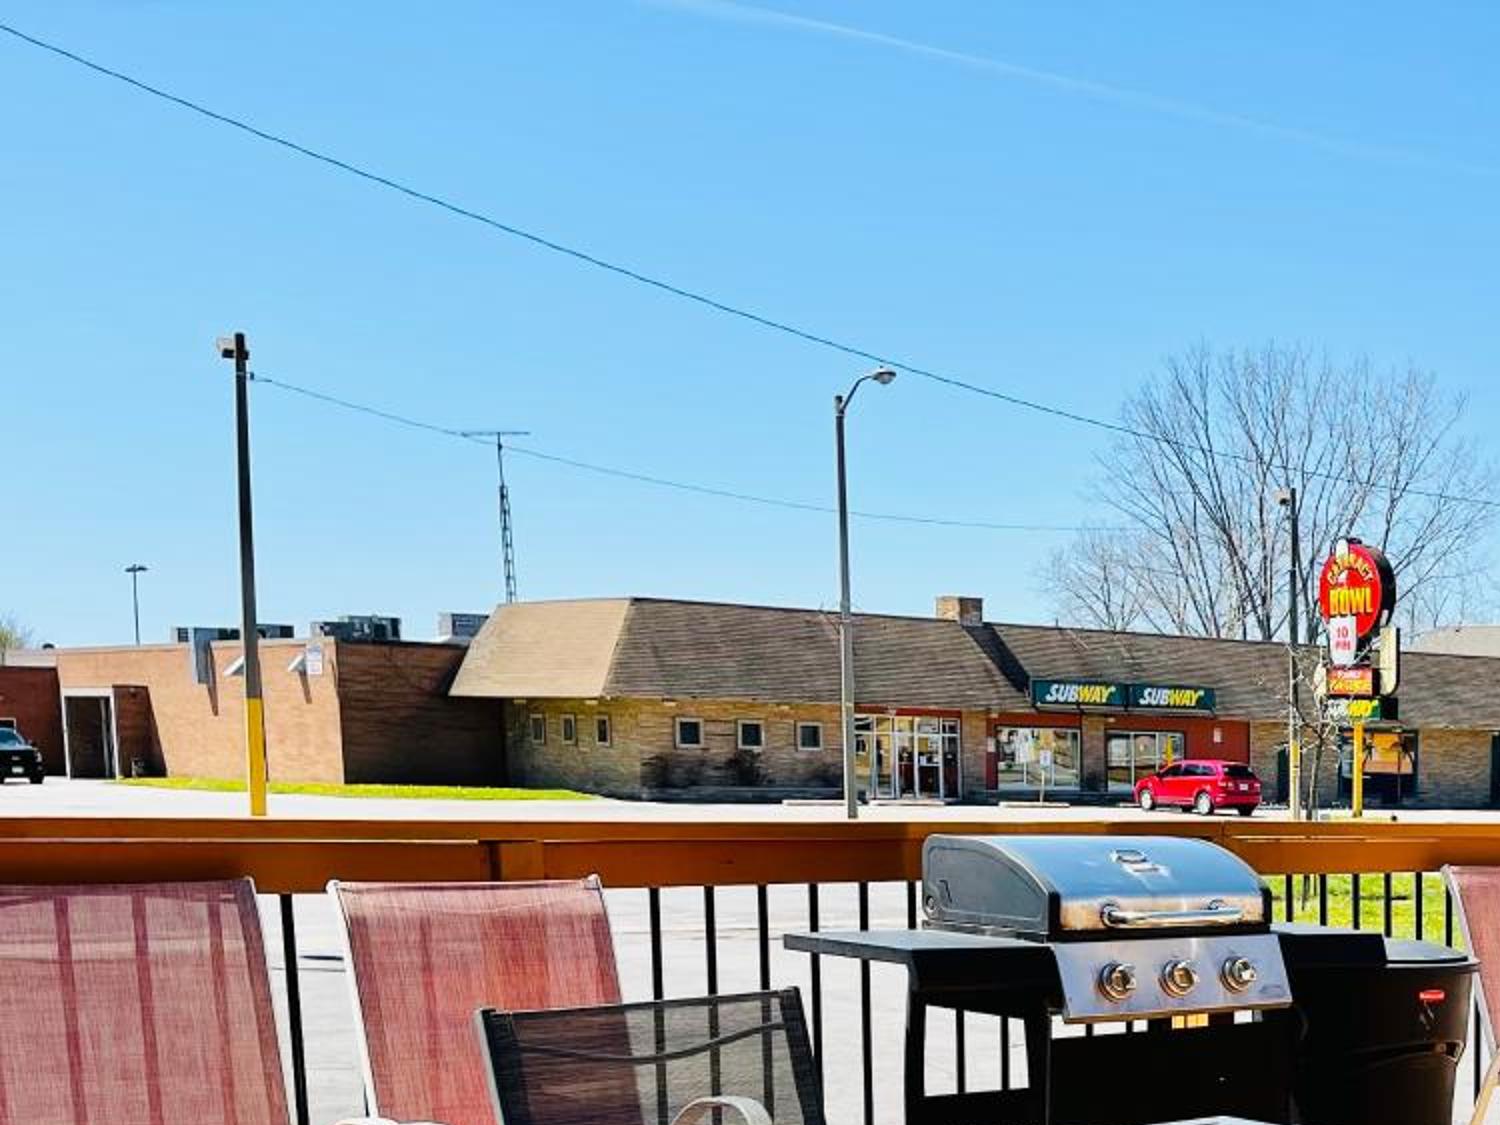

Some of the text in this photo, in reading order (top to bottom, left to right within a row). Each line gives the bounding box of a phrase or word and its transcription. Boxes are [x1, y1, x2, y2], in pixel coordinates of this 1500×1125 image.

[1329, 587, 1374, 616] BOWL
[1335, 625, 1349, 638] 10
[1046, 684, 1113, 703] SUBWAY
[1139, 687, 1202, 707] SUBWAY
